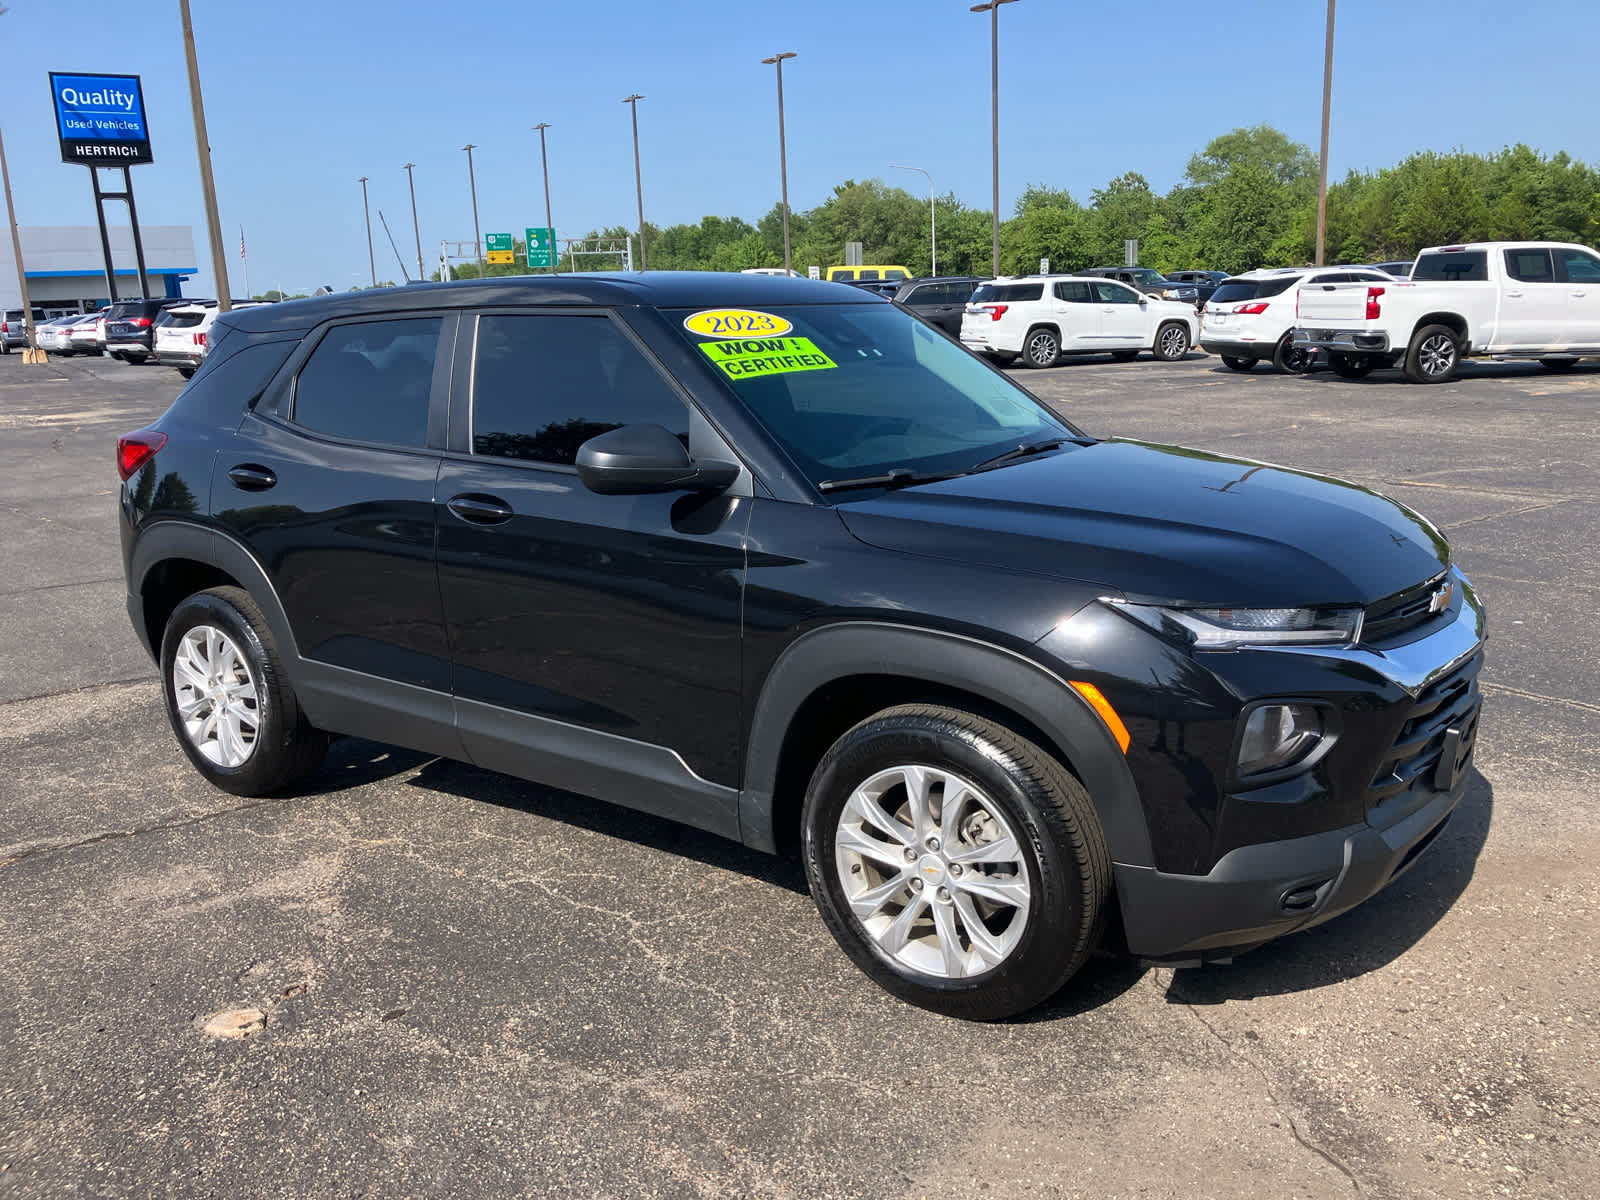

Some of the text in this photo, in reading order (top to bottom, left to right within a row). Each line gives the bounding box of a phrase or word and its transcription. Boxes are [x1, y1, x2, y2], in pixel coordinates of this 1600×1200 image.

[62, 88, 134, 110] Quality
[66, 119, 140, 130] Used Vehicles
[76, 145, 138, 156] HERTRICH
[706, 315, 775, 333] 2023
[725, 354, 827, 375] CERTIFIED
